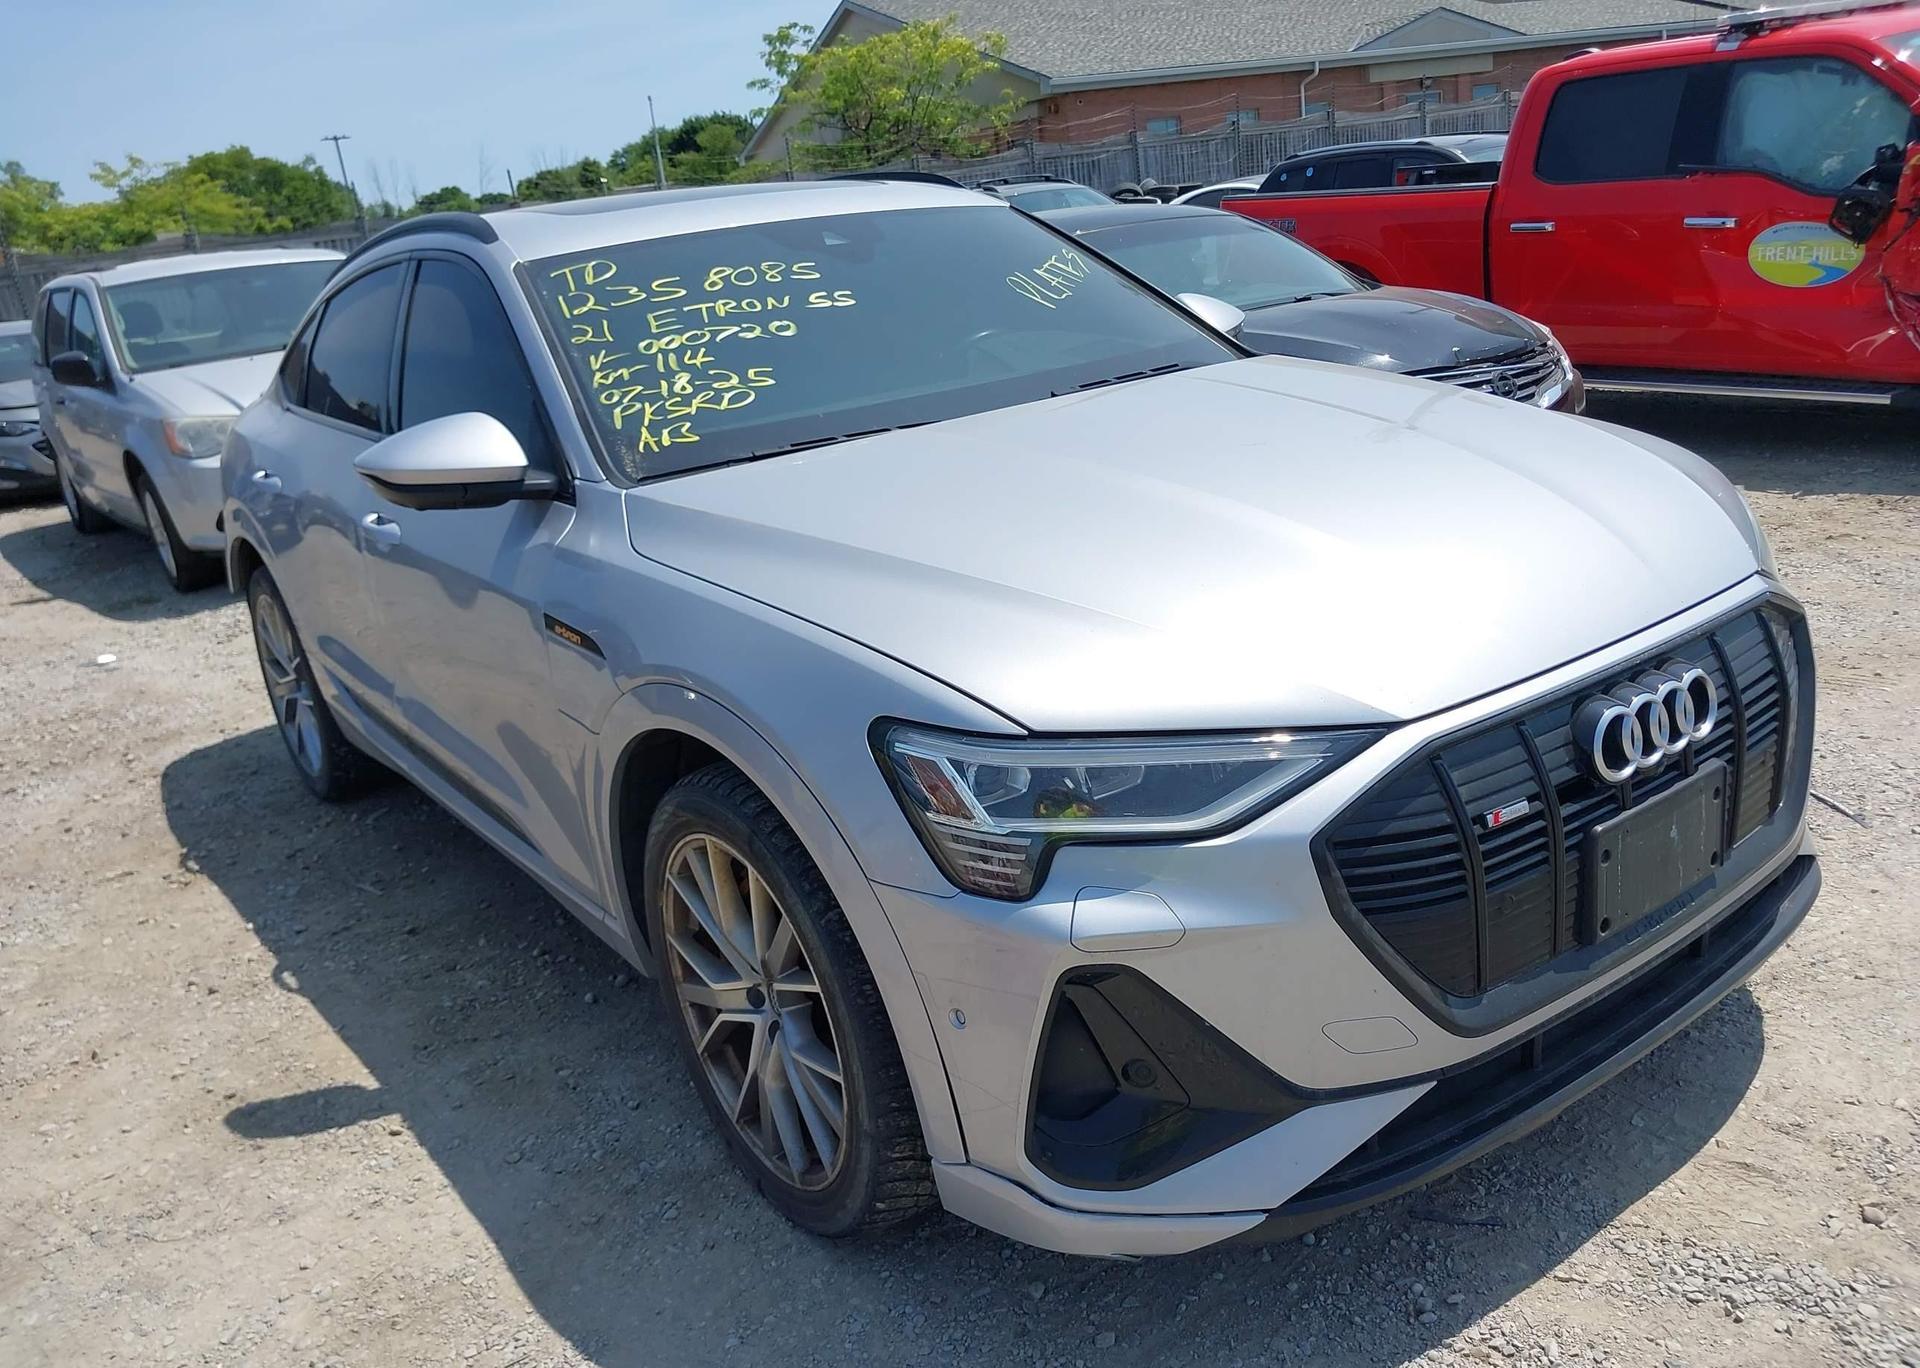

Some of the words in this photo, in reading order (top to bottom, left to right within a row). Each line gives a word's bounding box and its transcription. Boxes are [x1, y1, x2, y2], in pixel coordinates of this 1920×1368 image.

[1756, 247, 1807, 262] TRENT
[1812, 246, 1858, 261] HILLS
[550, 260, 617, 291] TD
[704, 262, 821, 291] 8085
[571, 319, 613, 344] 21
[804, 290, 857, 308] SS
[638, 320, 797, 354] 000720
[657, 347, 715, 372] 114
[600, 367, 776, 405] 07-18-25
[639, 422, 700, 453] AB
